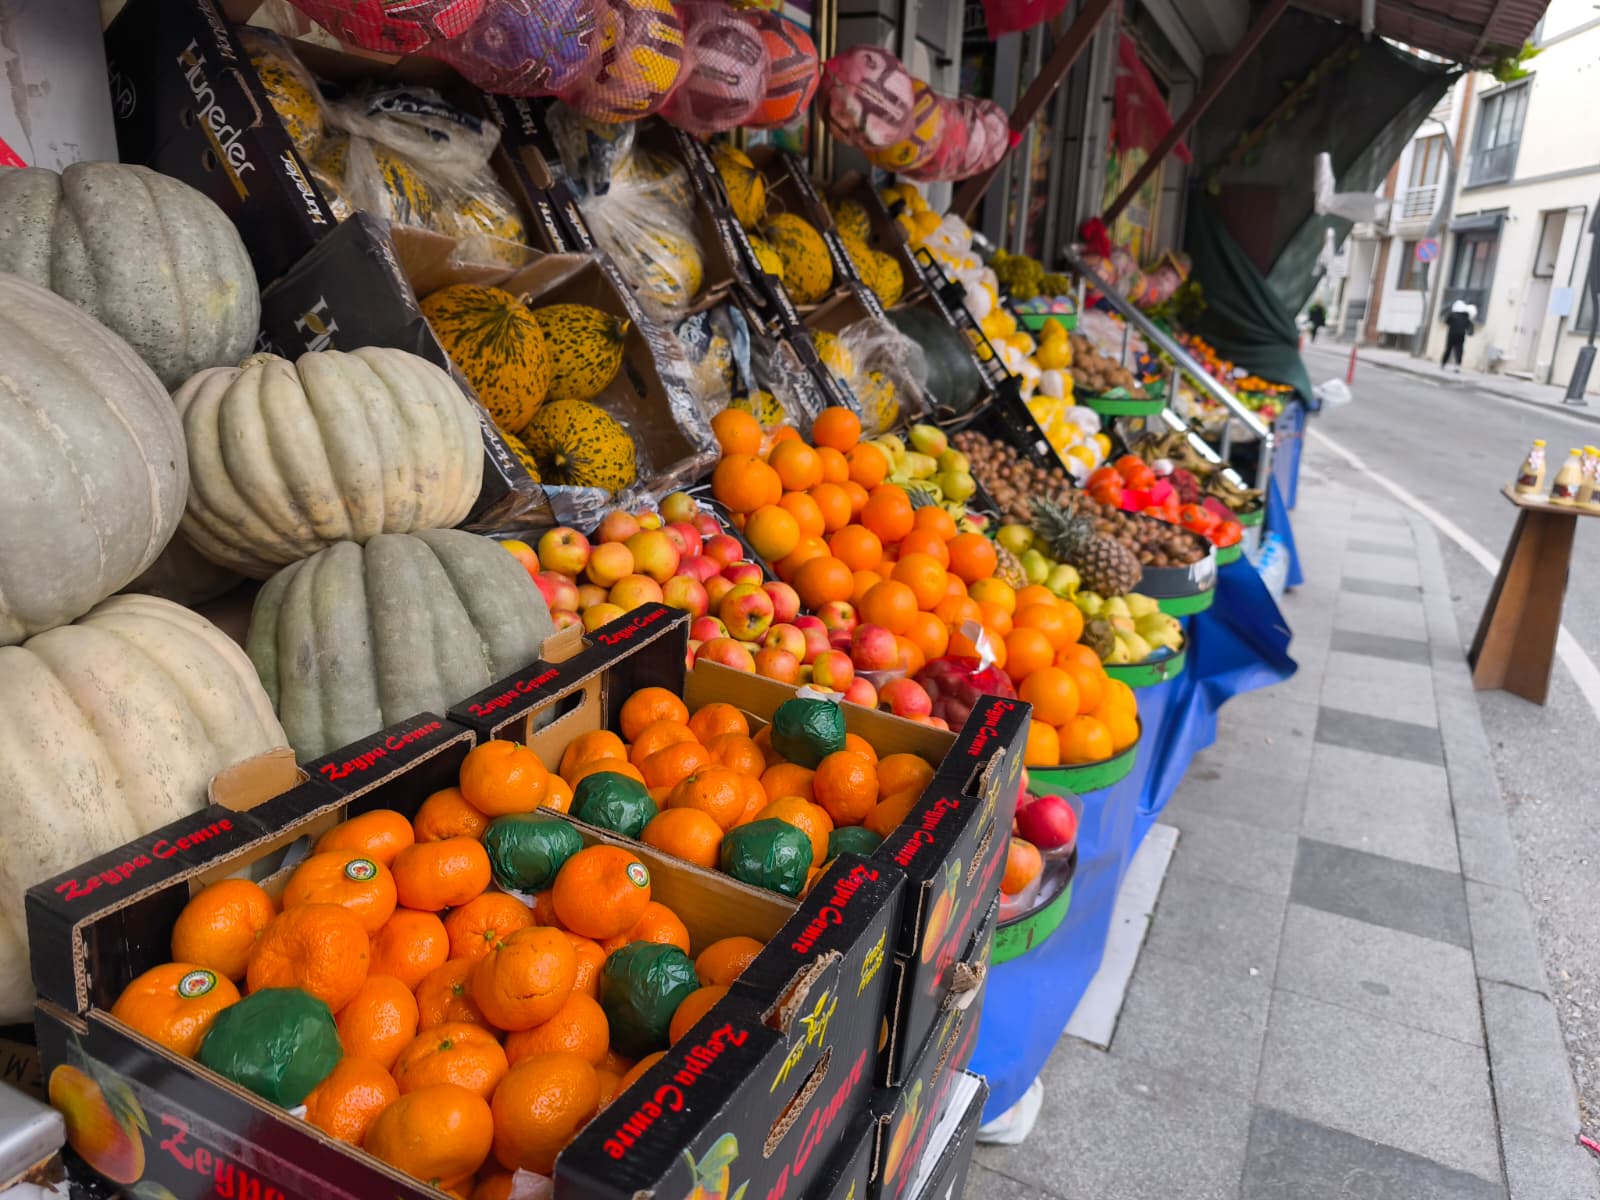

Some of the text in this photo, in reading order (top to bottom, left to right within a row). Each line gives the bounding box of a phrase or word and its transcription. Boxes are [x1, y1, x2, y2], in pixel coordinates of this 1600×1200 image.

[385, 721, 442, 751] Cemre
[55, 818, 233, 902] Zeypa Cemre
[791, 906, 843, 954] Cemre
[674, 1023, 749, 1086] Zeypa
[603, 1084, 684, 1160] Cemre
